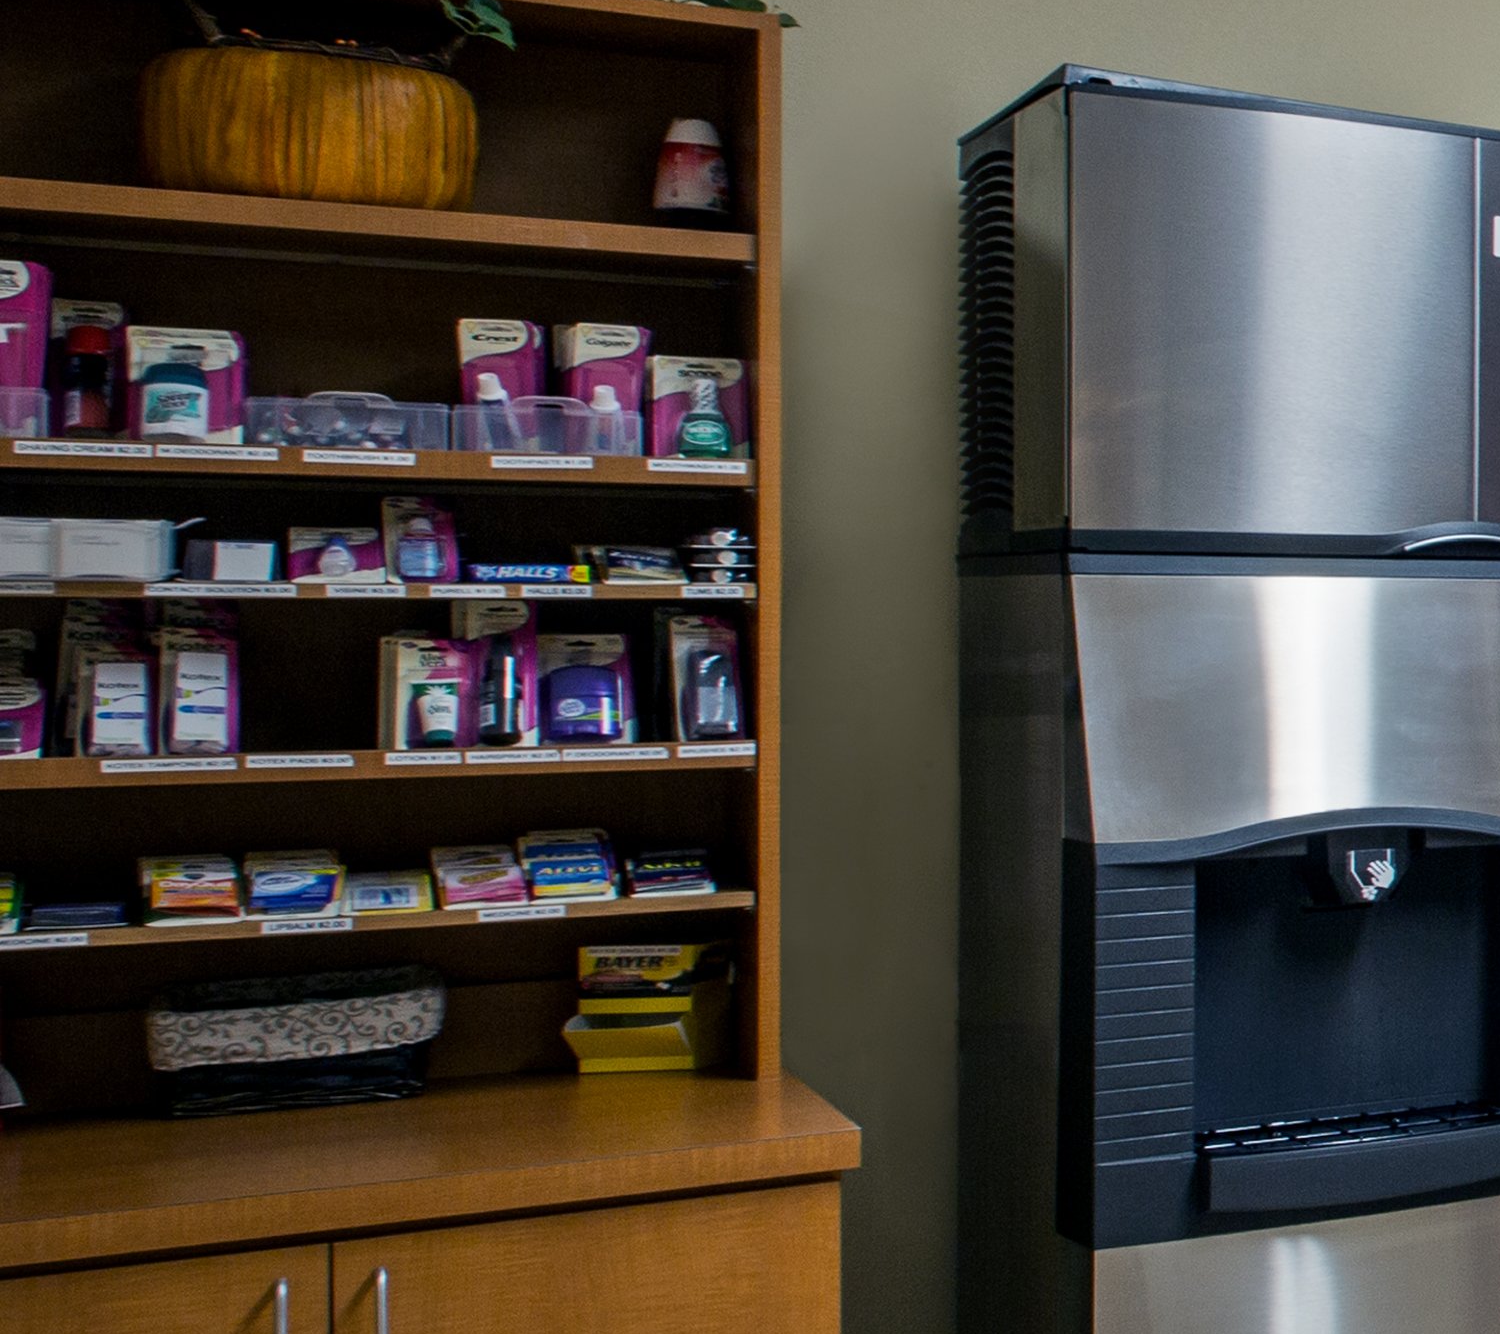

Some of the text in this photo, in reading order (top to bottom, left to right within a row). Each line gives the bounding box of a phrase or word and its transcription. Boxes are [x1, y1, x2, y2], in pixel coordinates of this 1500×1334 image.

[472, 333, 518, 343] Crest
[585, 337, 632, 348] Colgate
[73, 444, 115, 454] CREAM
[496, 566, 560, 580] HALLS
[525, 587, 560, 595] HALLS
[685, 587, 714, 595] TUMS
[388, 754, 428, 762] LOTION
[106, 761, 143, 769] KOTEX
[600, 956, 664, 968] BAYER
